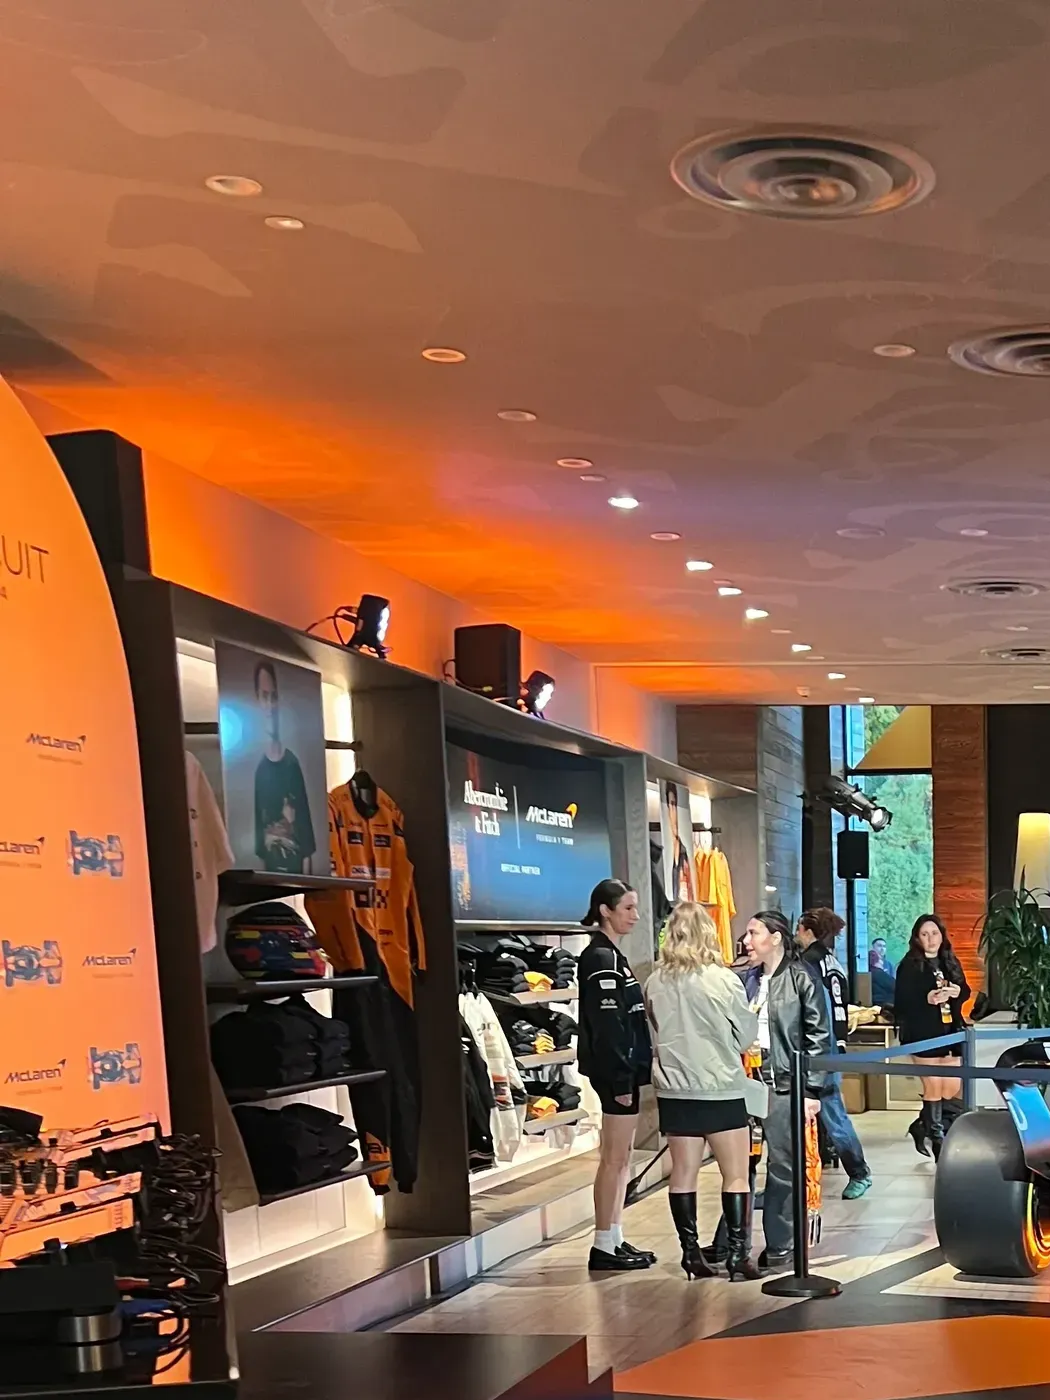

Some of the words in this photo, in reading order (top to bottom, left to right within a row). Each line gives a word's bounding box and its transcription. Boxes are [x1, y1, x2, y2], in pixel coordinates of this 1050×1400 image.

[0, 535, 49, 583] UIT
[25, 733, 82, 752] McLaren
[525, 805, 574, 829] McLaren
[0, 841, 40, 855] cLaren
[82, 954, 133, 967] McLaren
[4, 1066, 62, 1084] McLaren
